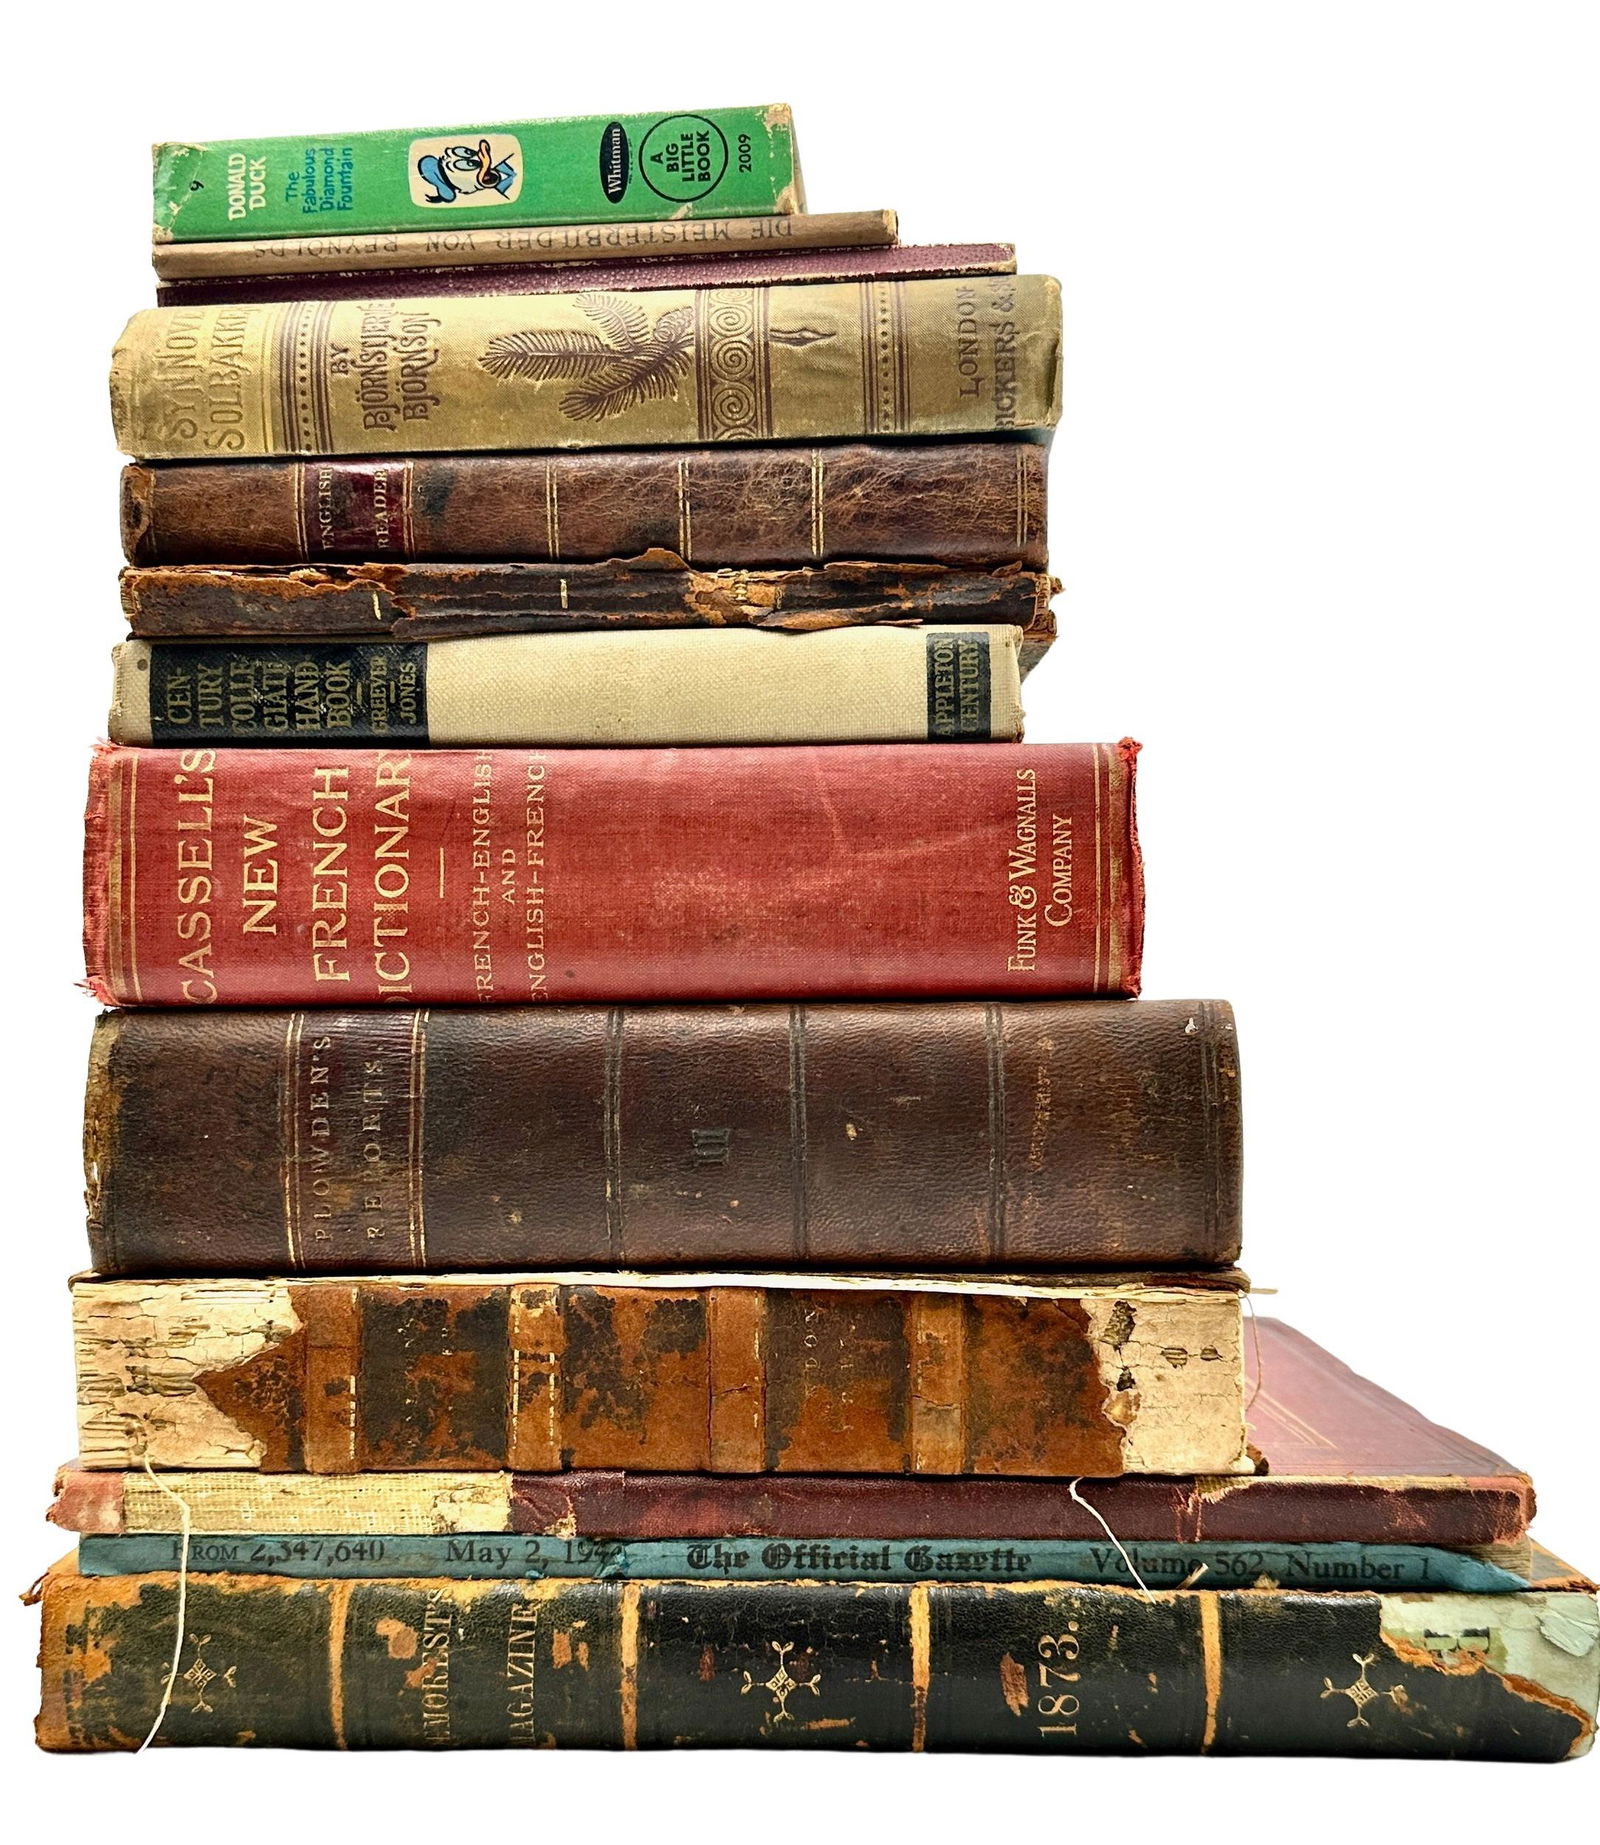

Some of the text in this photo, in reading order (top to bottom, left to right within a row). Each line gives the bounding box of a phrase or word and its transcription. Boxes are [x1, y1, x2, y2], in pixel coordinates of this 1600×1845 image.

[226, 153, 247, 221] DONALD
[249, 156, 267, 211] DUCK
[285, 171, 300, 202] The
[301, 147, 318, 214] Fabulous
[319, 147, 335, 212] Diamond
[337, 147, 353, 211] Fountain
[608, 128, 623, 195] Whitman
[650, 151, 664, 165] A
[666, 143, 679, 173] BIG
[681, 133, 695, 182] LITTLE
[697, 130, 711, 182] BOOK
[738, 134, 752, 173] 2009
[254, 218, 792, 259] DIE MEISTERBILDER VON REYNOLDS
[329, 342, 349, 376] BY
[392, 311, 441, 423] BJÖRNSON
[956, 286, 985, 398] LONDON
[318, 467, 335, 550] ENGLISH
[373, 469, 391, 550] READER
[167, 667, 192, 726] CEN-
[198, 664, 224, 728] TURY
[263, 661, 289, 735] GIATE
[325, 660, 352, 729] BOOK
[369, 654, 388, 735] GREEVER
[400, 661, 417, 725] JONES
[934, 637, 955, 737] APPLETON
[958, 639, 980, 734] CENTURY
[175, 748, 217, 1005] CASSELL'S
[242, 815, 280, 936] NEW
[312, 766, 351, 982] FRENCH
[373, 751, 413, 1003] ICTIONAR
[501, 848, 516, 905] AND
[1007, 768, 1037, 972] FUNK & WAGNALLS
[1044, 814, 1073, 927] COMPANY
[309, 1036, 333, 1242] PLOWDEN'S
[445, 1539, 512, 1569] May
[525, 1540, 549, 1569] 2,
[686, 1543, 750, 1574] The
[761, 1543, 892, 1572] Official
[904, 1545, 1033, 1573] Gazette
[1089, 1547, 1204, 1574] Volume
[1286, 1551, 1404, 1579] Number
[1420, 1557, 1430, 1580] 1
[421, 1588, 452, 1741] EMOREST'S
[1037, 1620, 1081, 1738] 1873.
